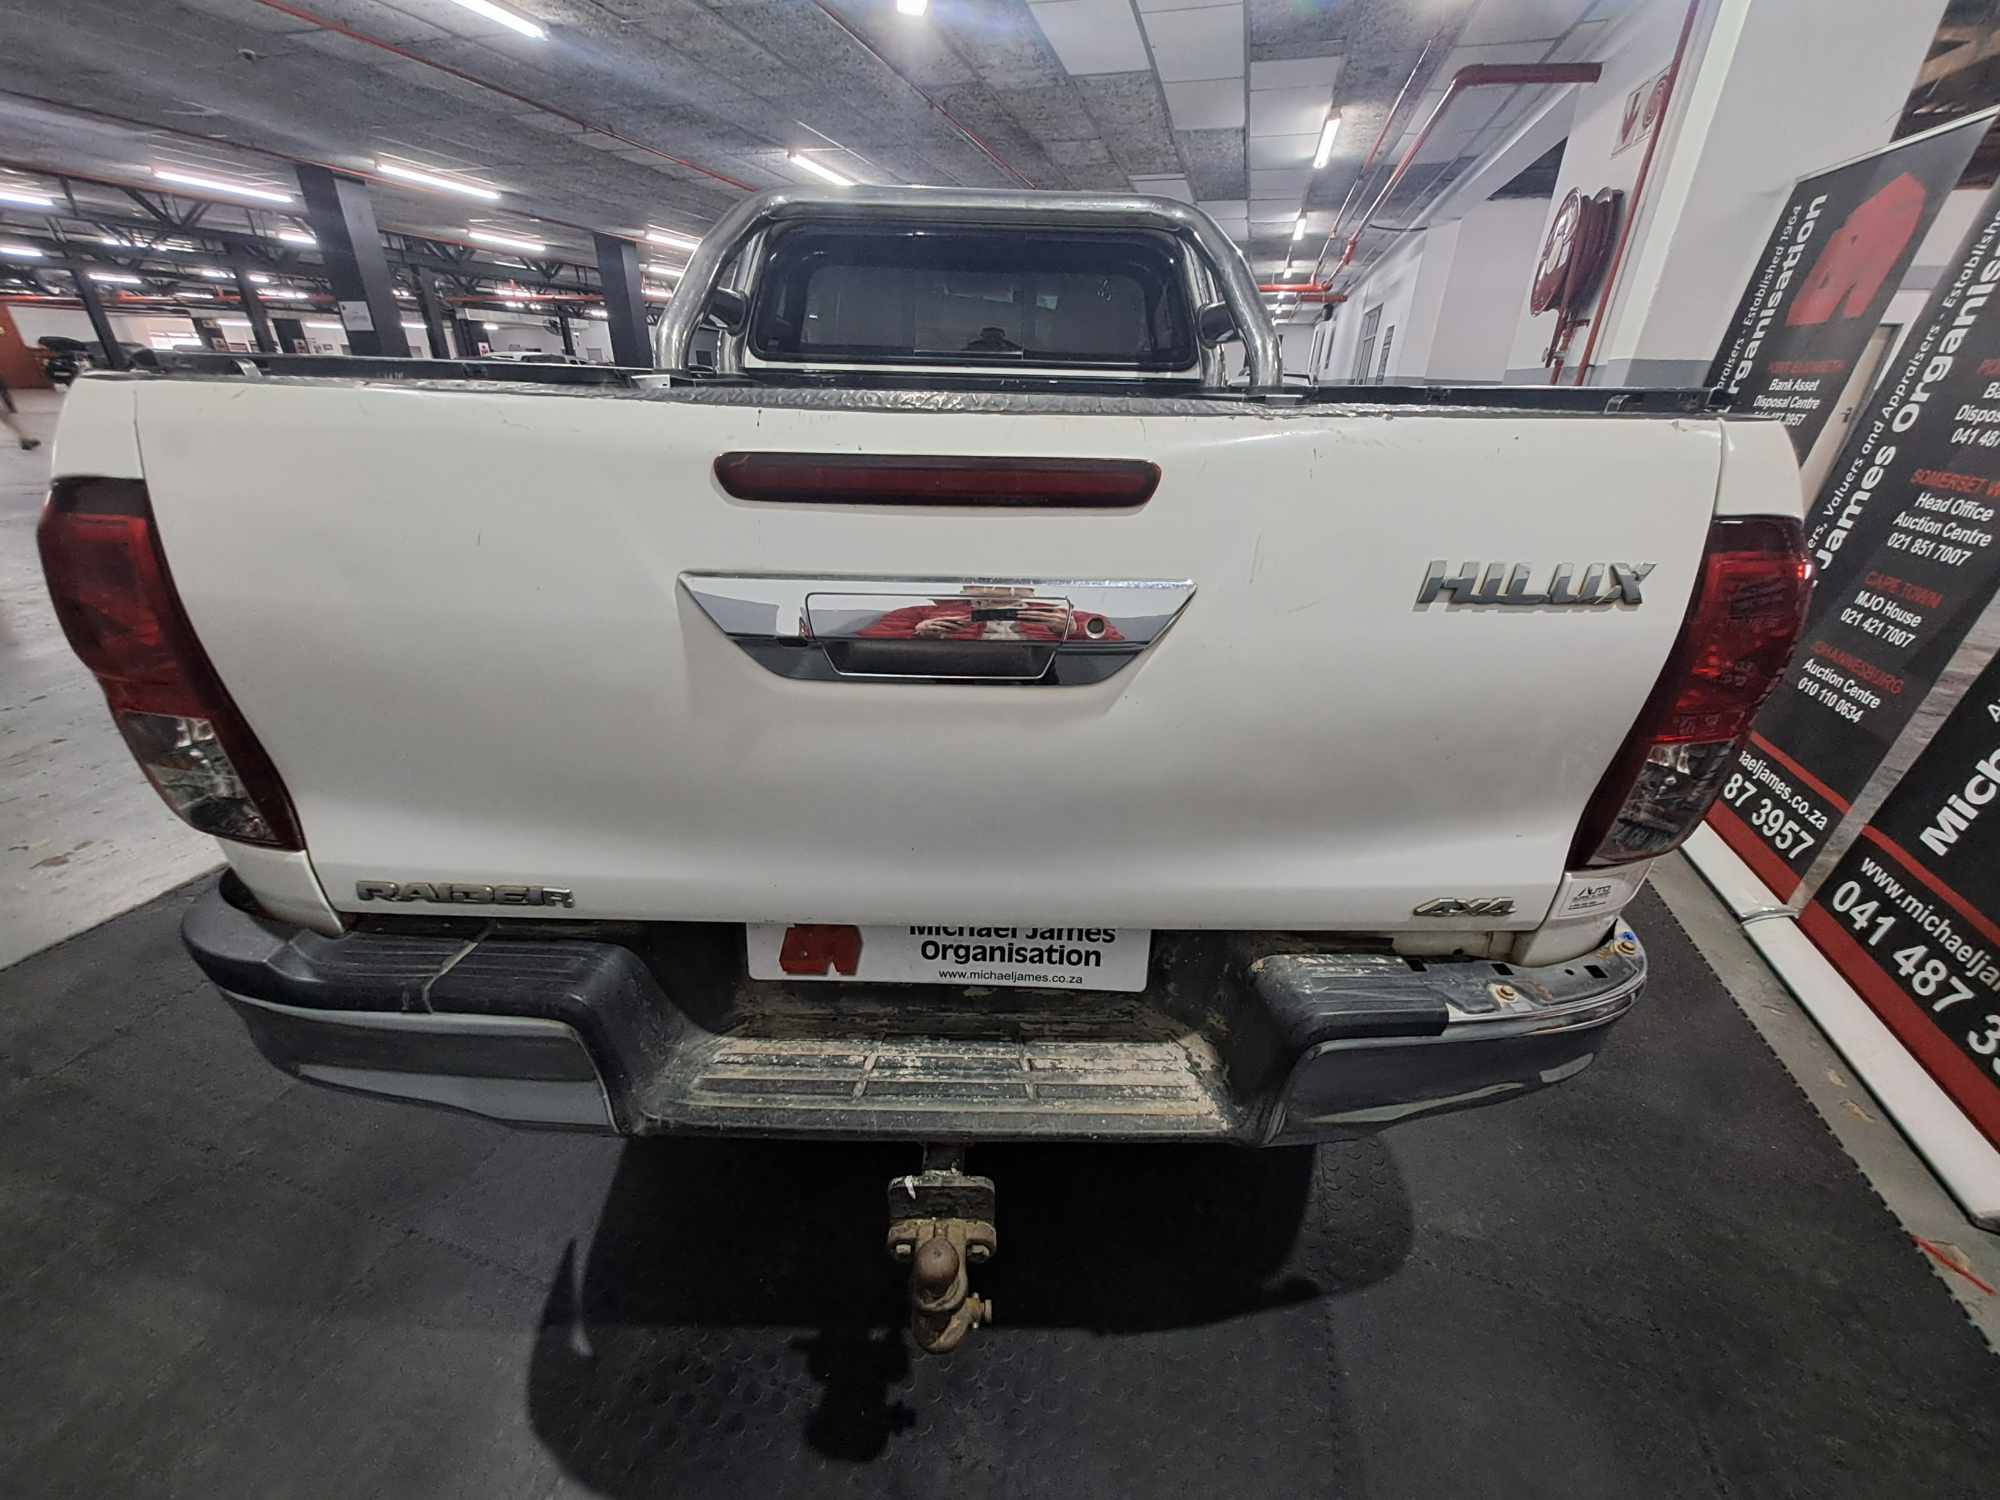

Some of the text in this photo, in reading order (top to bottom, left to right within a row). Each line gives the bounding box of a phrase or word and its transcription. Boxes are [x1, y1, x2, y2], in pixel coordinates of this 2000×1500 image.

[1743, 246, 1785, 326] Established
[1780, 205, 1802, 241] 1964
[1753, 395, 1821, 409] Disposal Centre
[1768, 378, 1821, 391] Bank Asset
[1823, 458, 1864, 517] Valuers
[1862, 421, 1885, 455] and
[1882, 325, 1941, 419] Appraisers
[1950, 427, 2000, 448] 041 48
[1816, 445, 1897, 569] James
[1914, 491, 1995, 522] Head Office
[1892, 511, 1993, 547] Auction Centre
[1887, 532, 1973, 567] 021 851 7007
[1416, 559, 1658, 606] HILUX
[1854, 590, 1923, 628] MJO House
[1840, 608, 1916, 648] 021 421 7007
[1797, 677, 1865, 724] 010 110 0634
[1802, 658, 1882, 709] Auction Centre
[1723, 773, 1816, 859] 87 3957
[355, 879, 576, 909] RAIDER
[920, 939, 1102, 968] Organisation
[1025, 927, 1116, 943] James
[1832, 881, 1897, 946] 041
[1893, 945, 1976, 1013] 487
[938, 968, 1084, 985] www.michaeljames.co.za
